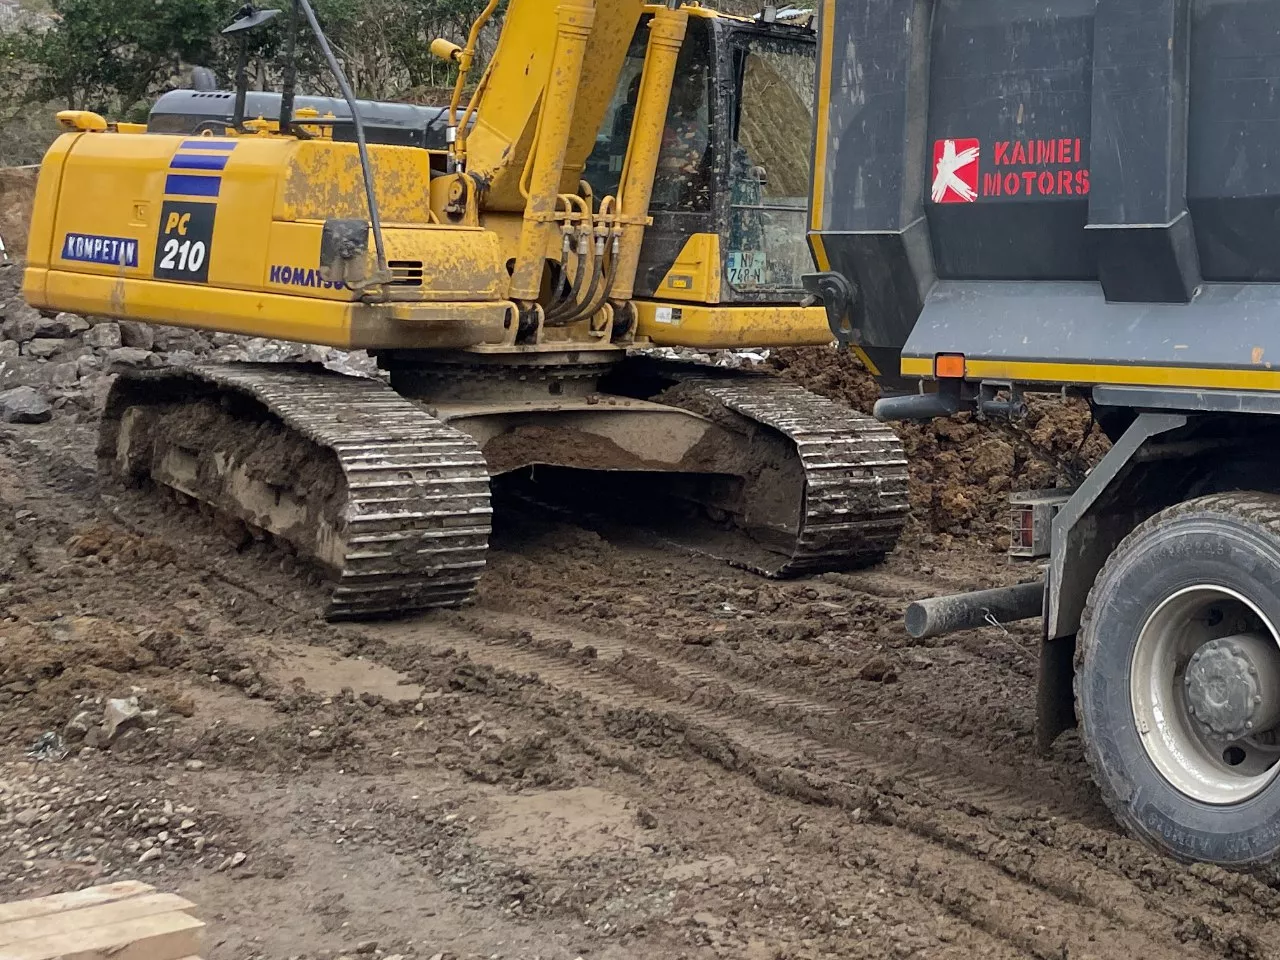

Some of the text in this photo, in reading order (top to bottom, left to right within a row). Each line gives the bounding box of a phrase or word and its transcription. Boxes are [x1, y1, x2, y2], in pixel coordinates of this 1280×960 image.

[994, 137, 1081, 166] KAIMEI
[983, 169, 1091, 197] MOTORS
[164, 212, 191, 236] PC
[159, 238, 206, 272] 210
